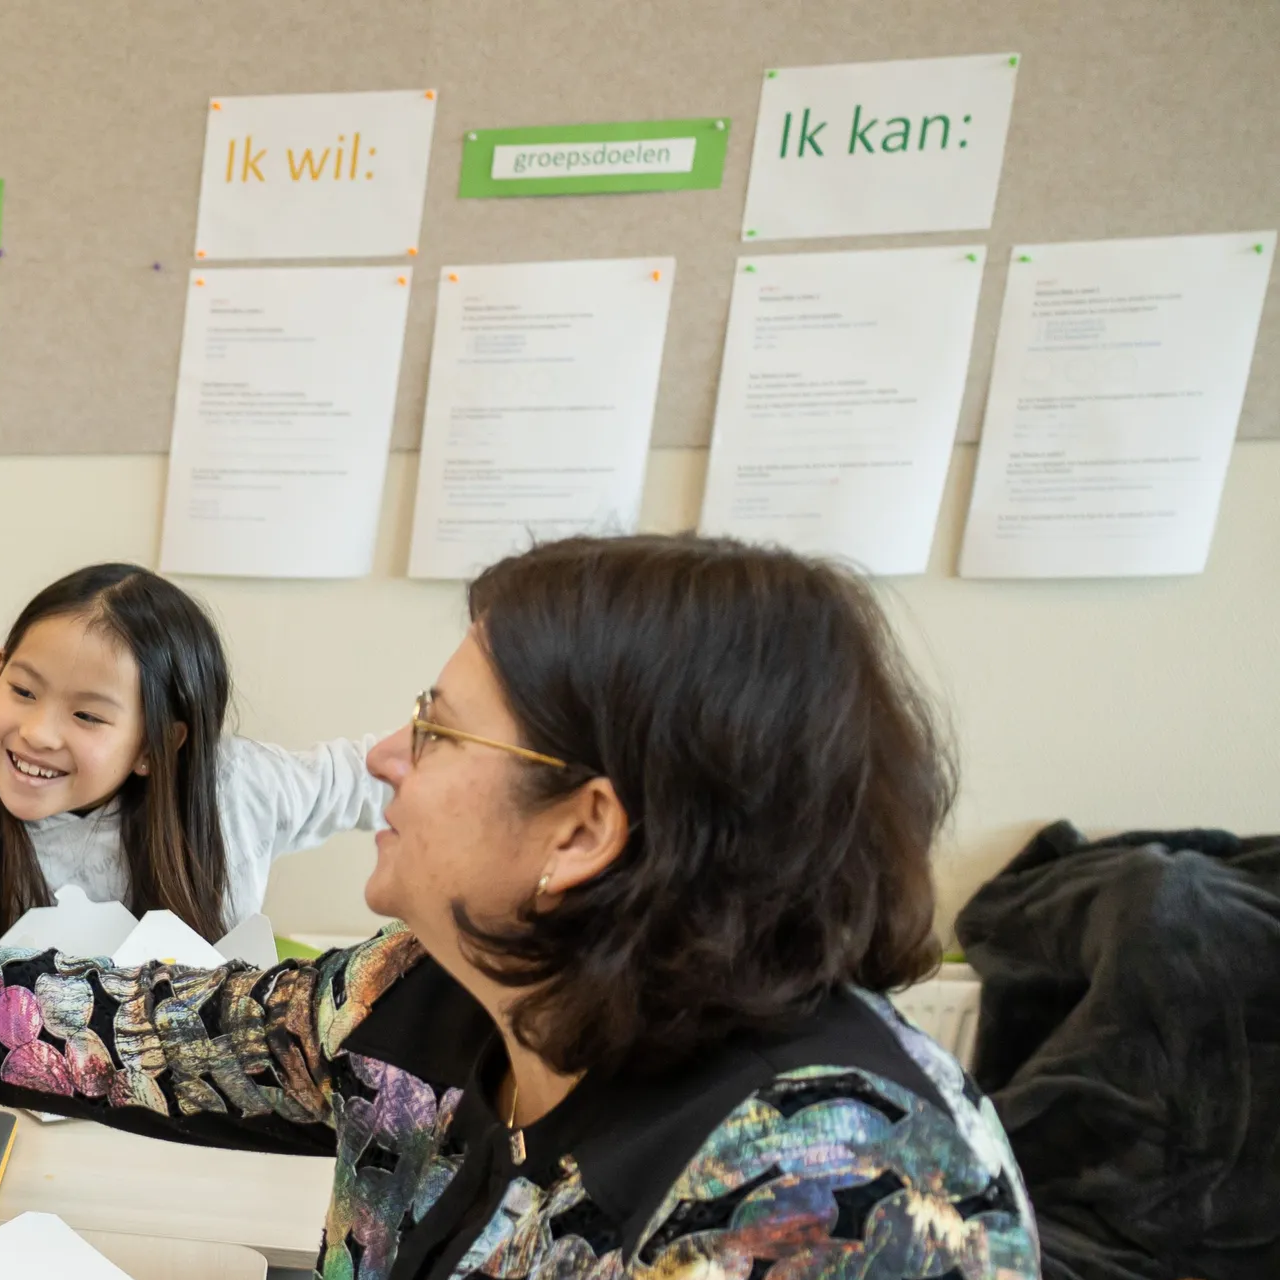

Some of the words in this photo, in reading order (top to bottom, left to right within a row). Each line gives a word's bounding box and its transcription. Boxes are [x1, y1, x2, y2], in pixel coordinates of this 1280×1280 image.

[226, 134, 268, 183] Ik
[286, 131, 377, 182] wil:
[780, 108, 828, 159] Ik
[848, 104, 972, 155] kan:
[513, 143, 671, 173] groepsdoelen
